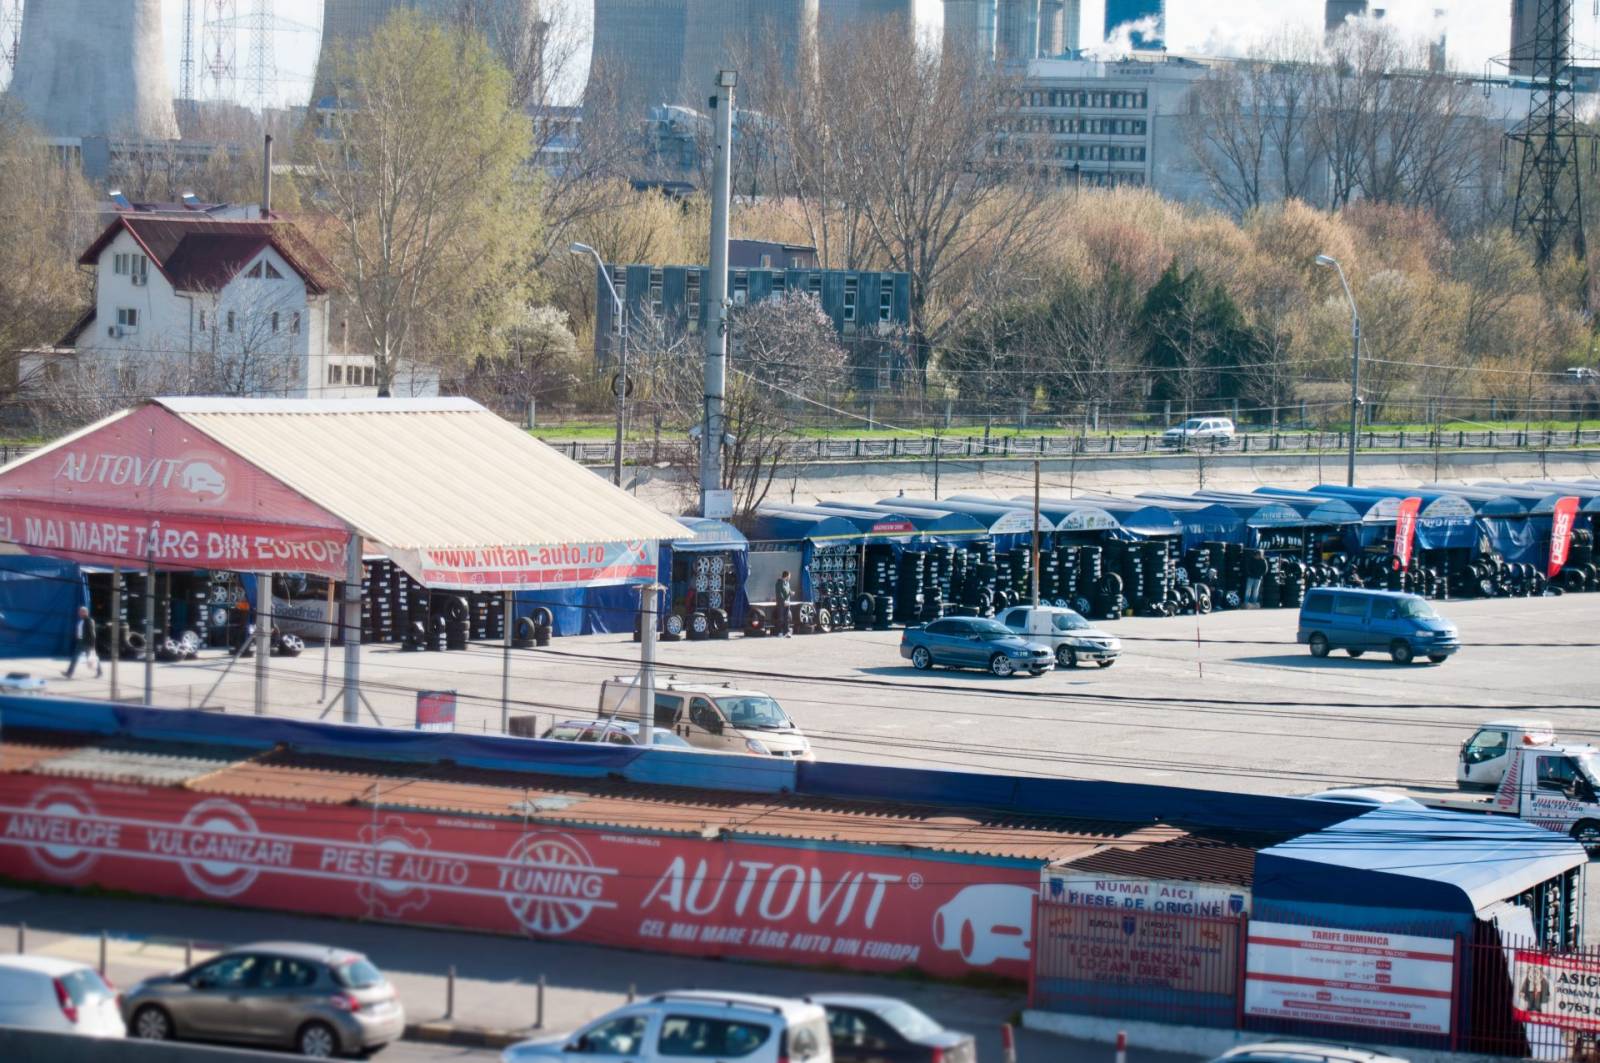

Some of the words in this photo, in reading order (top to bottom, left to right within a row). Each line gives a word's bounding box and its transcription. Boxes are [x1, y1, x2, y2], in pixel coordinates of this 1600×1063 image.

[55, 452, 183, 488] AUTOVIT
[25, 517, 64, 549] MAI
[70, 520, 129, 554] MARE
[135, 520, 199, 560] TÂRG
[207, 532, 249, 560] DIN
[427, 542, 605, 568] www.vitan-auto.ro
[5, 815, 121, 849] ANVELOPE
[147, 828, 294, 866] VULCANIZARI
[320, 847, 392, 877] PIESE
[398, 856, 470, 886] AUTO
[497, 864, 604, 899] TUNING
[641, 856, 902, 930] AUTOVIT
[1069, 890, 1118, 907] PIESE
[1124, 898, 1145, 909] DE
[1154, 901, 1222, 917] ORIGINE
[1095, 880, 1149, 896] NUMAI
[1160, 887, 1194, 901] AICI
[639, 919, 665, 939] CEL
[668, 922, 697, 942] MAI
[700, 925, 746, 946] MARE
[789, 933, 830, 954] AUTO
[833, 937, 861, 956] DIN
[864, 939, 920, 964] EUROPA
[1312, 930, 1341, 941] TARIFE
[1343, 933, 1389, 946] DUMINICA
[1557, 972, 1600, 988] ASIG
